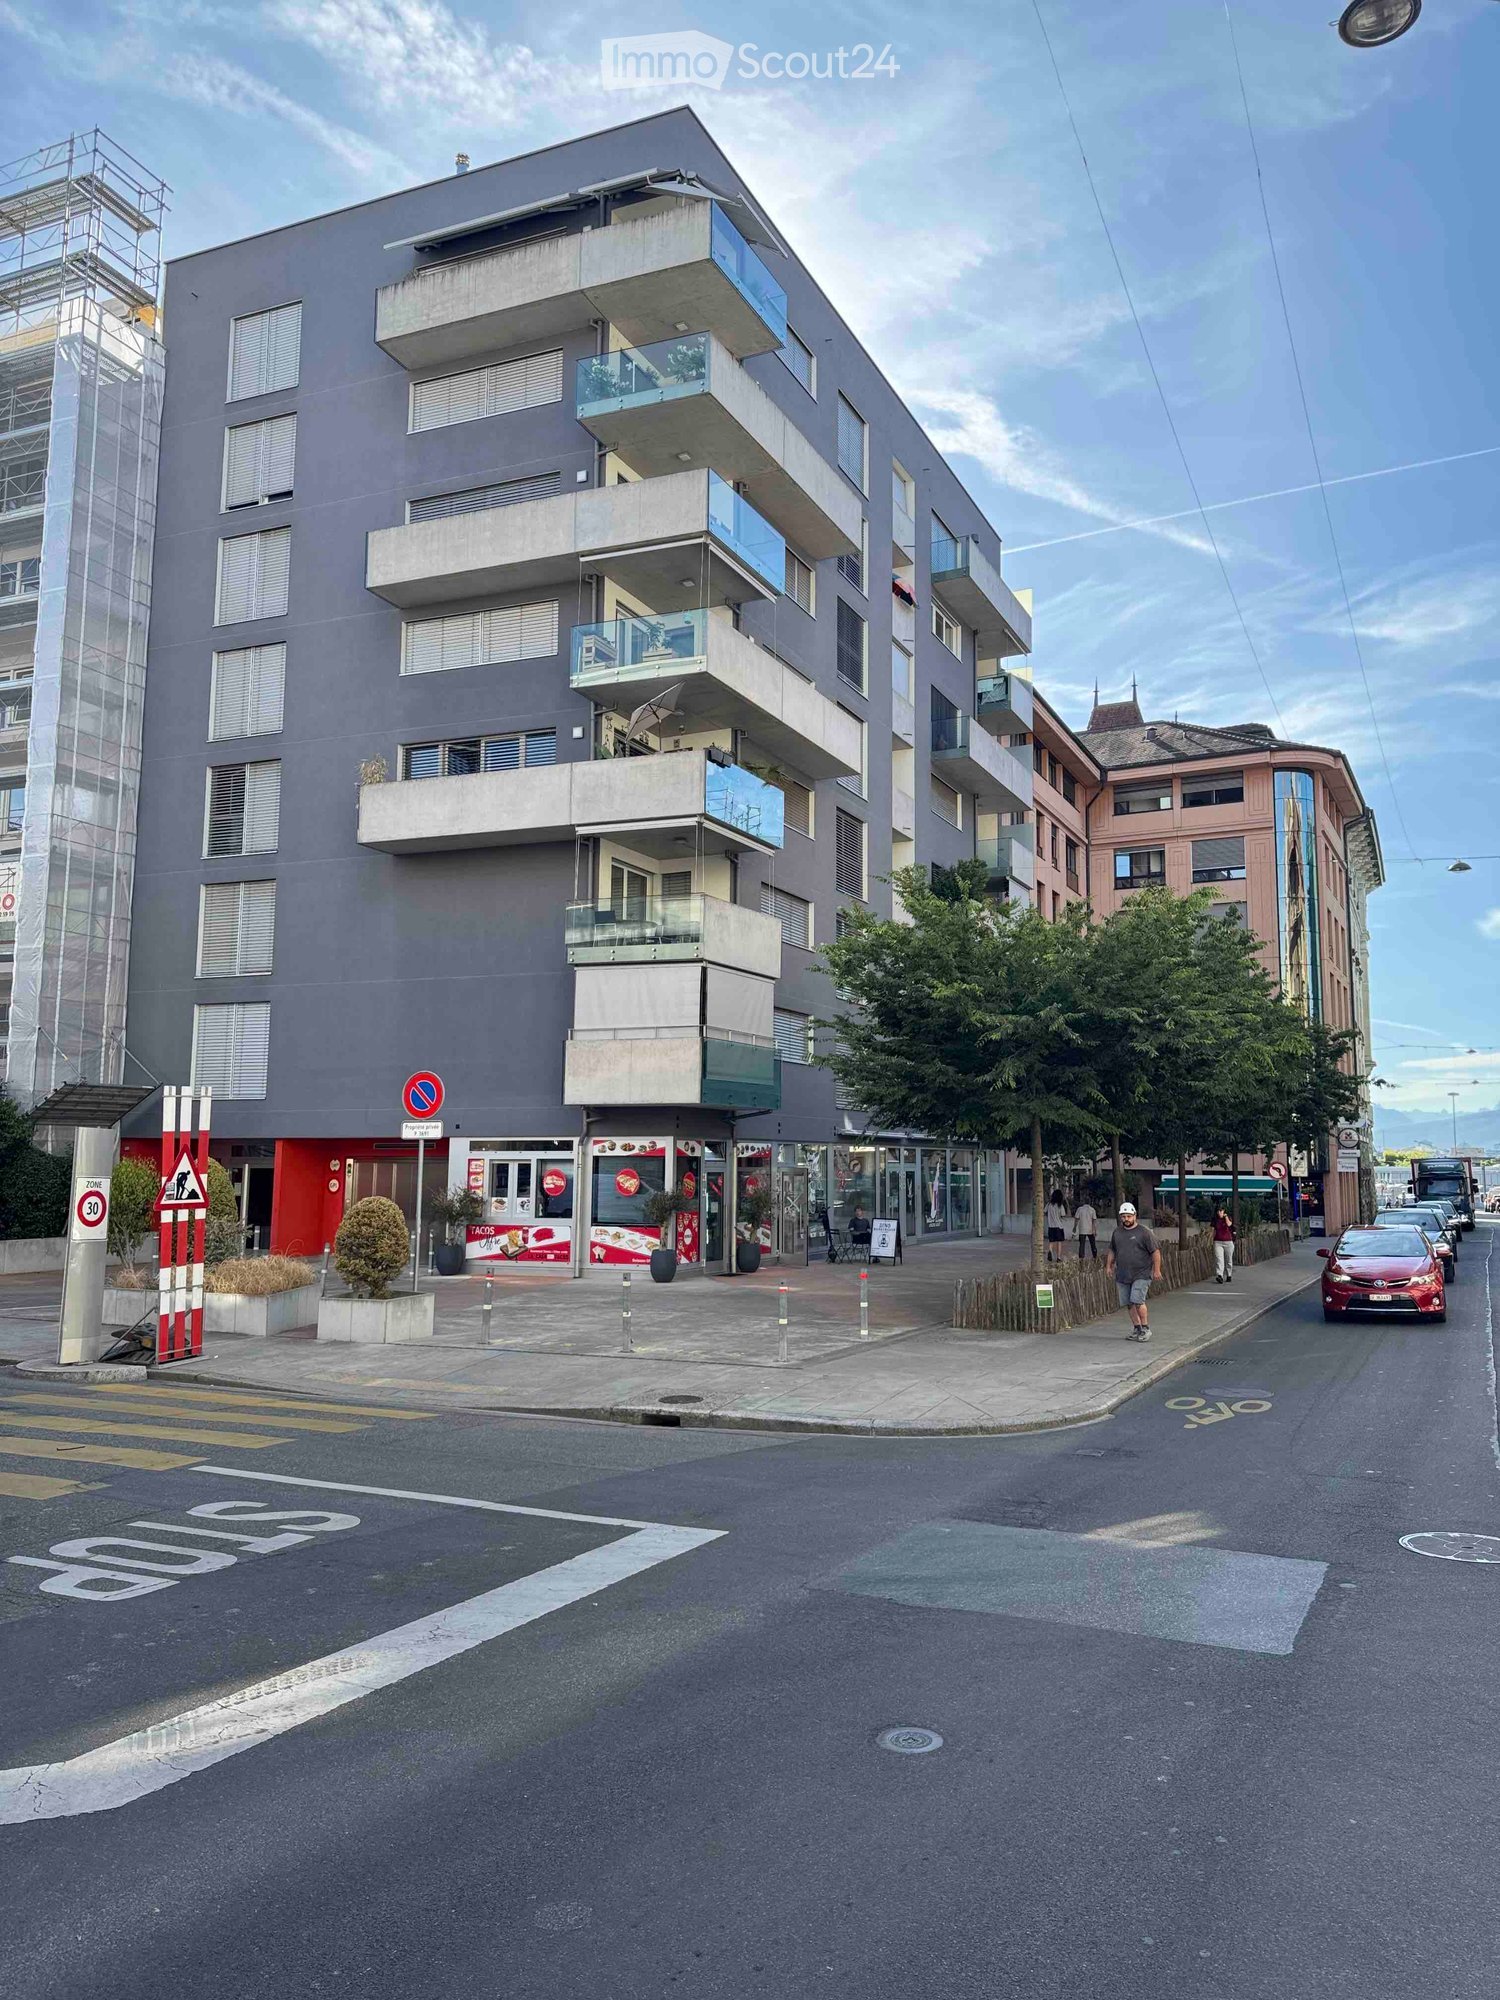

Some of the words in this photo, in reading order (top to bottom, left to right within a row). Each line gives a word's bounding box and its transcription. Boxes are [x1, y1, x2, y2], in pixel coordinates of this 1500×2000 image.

[85, 1180, 102, 1189] ZONE
[86, 1201, 99, 1216] 30
[471, 1226, 495, 1235] TACOS
[6, 1500, 361, 1602] STOP
